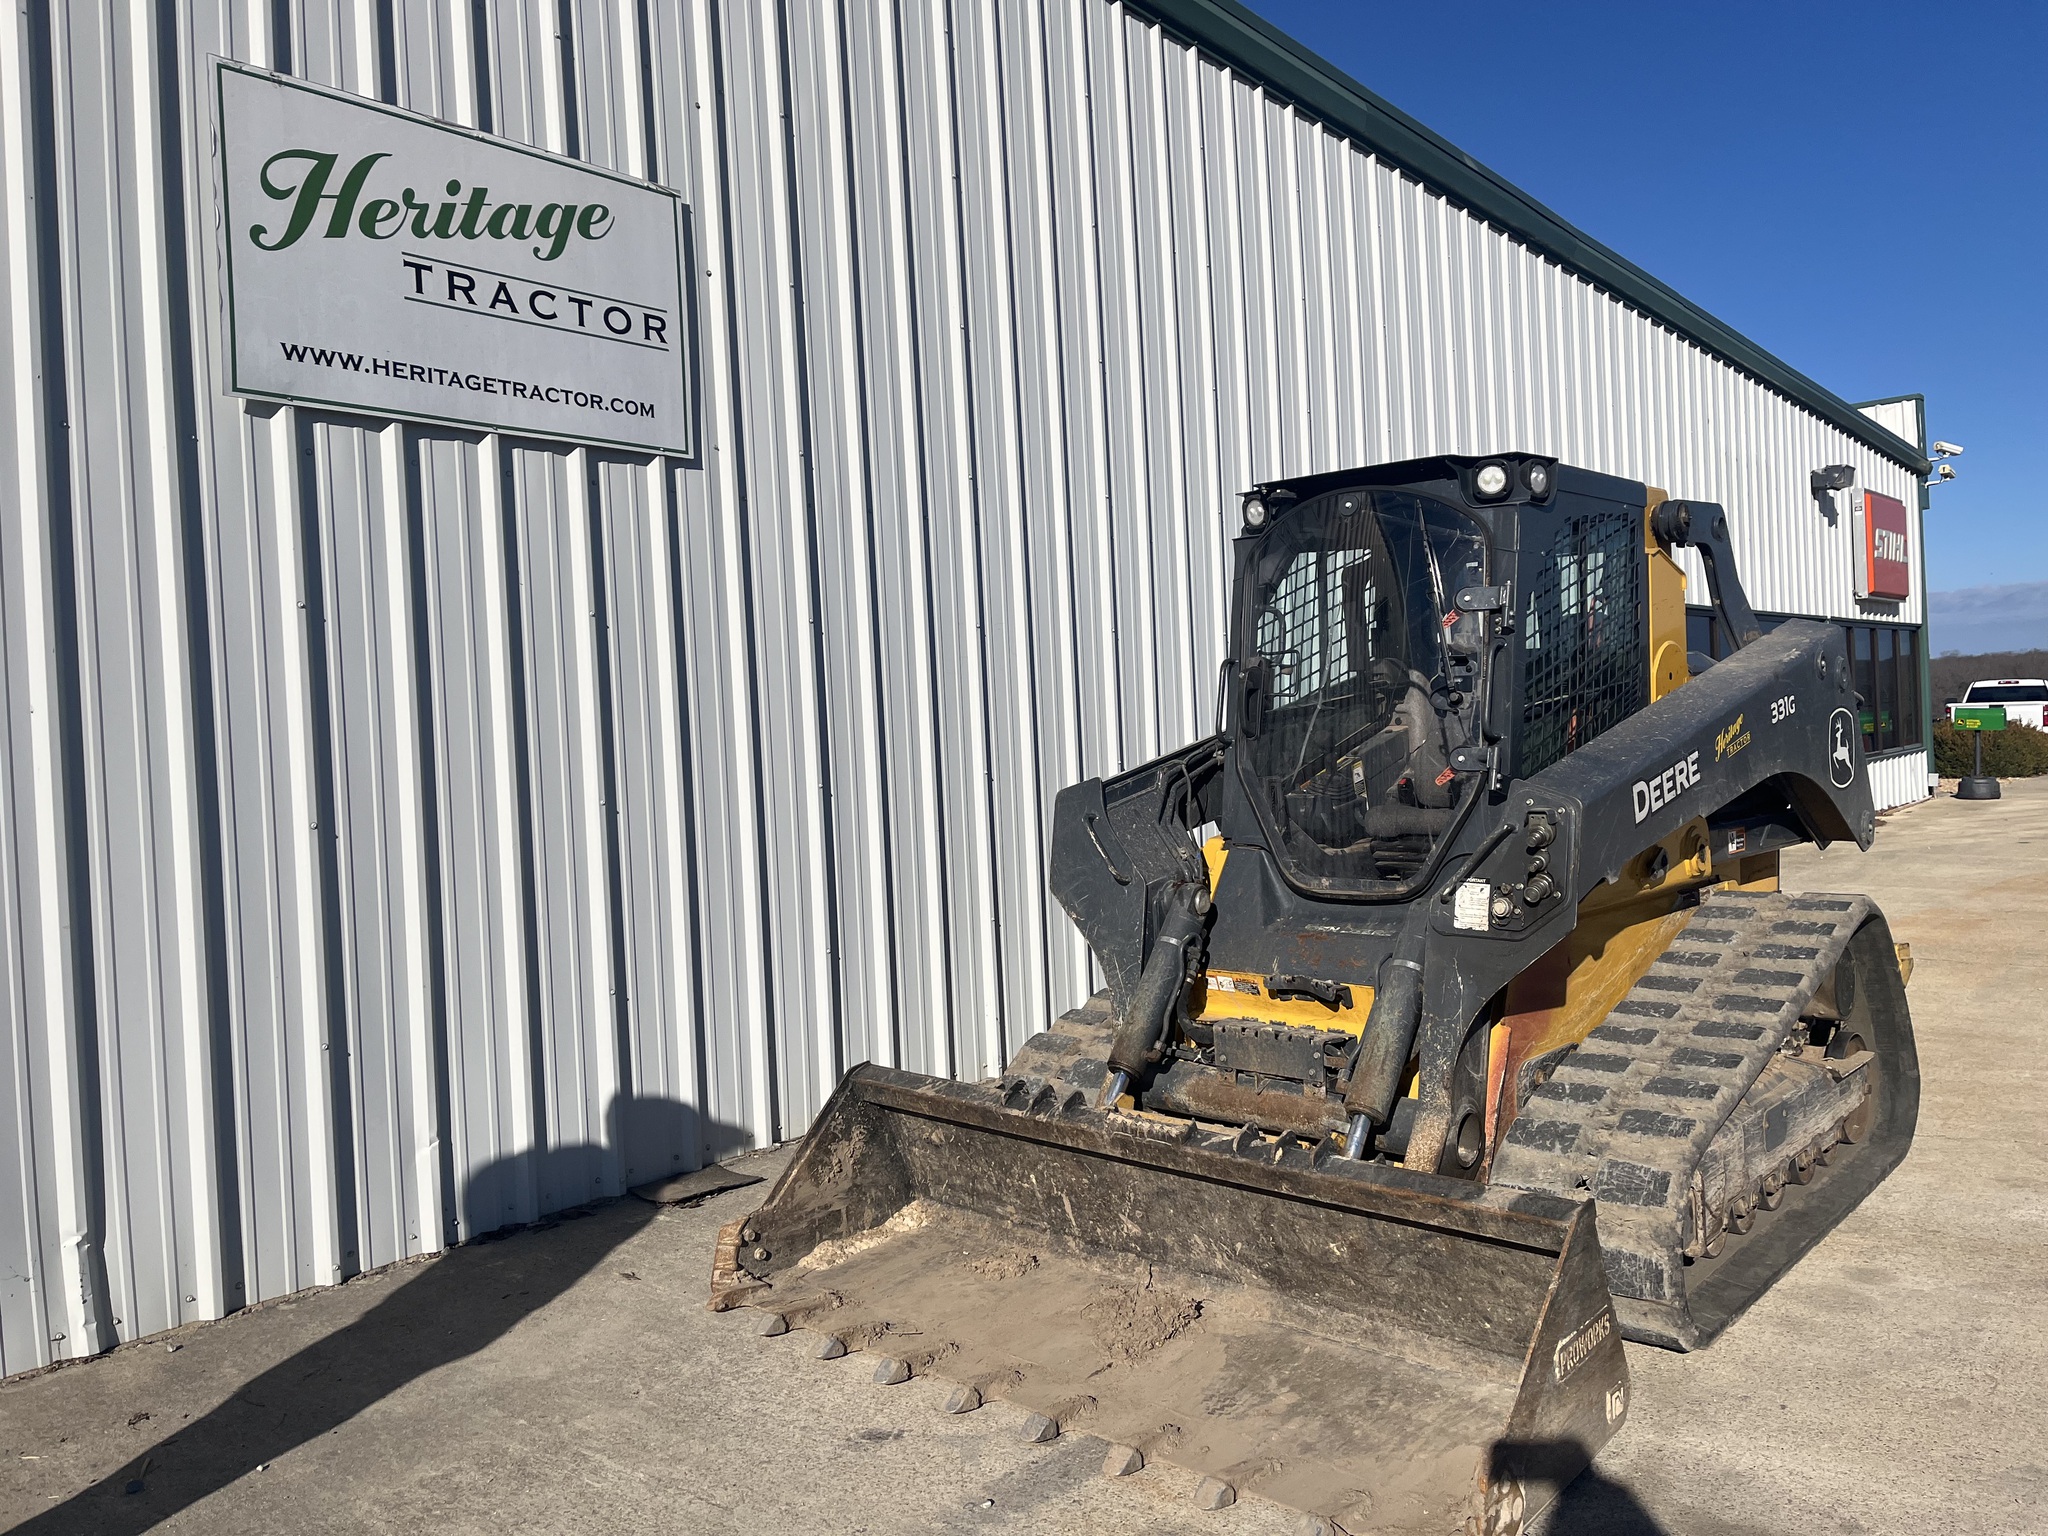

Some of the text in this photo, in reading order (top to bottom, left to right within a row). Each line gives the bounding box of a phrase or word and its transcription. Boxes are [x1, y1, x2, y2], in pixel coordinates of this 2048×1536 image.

[249, 148, 614, 260] Heritage
[402, 259, 669, 344] TRACTOR
[280, 341, 655, 419] WWW.HERITAGETRACTOR.COM
[1874, 528, 1908, 563] STIHL
[1714, 713, 1744, 762] Heritage
[1770, 695, 1796, 724] 331G
[1726, 733, 1751, 755] TRACTOR
[1632, 750, 1701, 825] DEERE
[1560, 1313, 1611, 1376] PROWORKS
